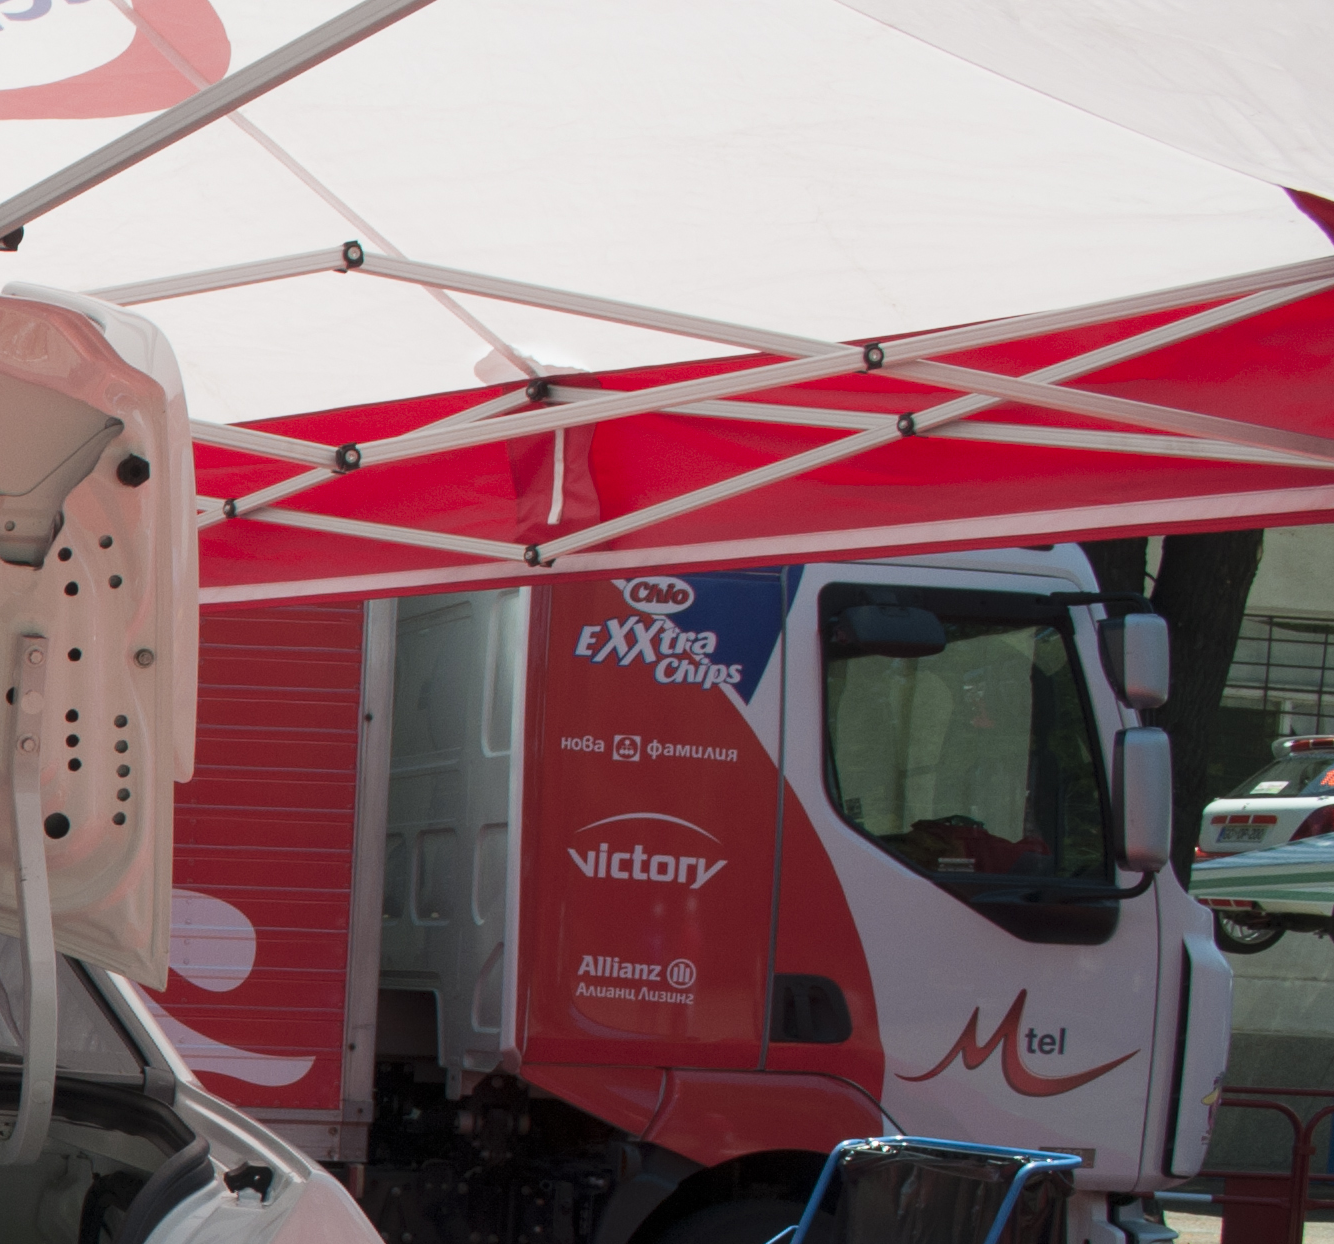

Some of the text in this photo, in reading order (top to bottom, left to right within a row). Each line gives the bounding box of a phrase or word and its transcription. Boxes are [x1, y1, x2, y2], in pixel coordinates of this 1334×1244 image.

[629, 581, 690, 606] Chio
[655, 656, 743, 690] Chips
[561, 736, 738, 762] нова фамилия
[567, 843, 728, 890] victory
[577, 955, 662, 981] Allianz
[575, 982, 694, 1005] Алианц Лизинг
